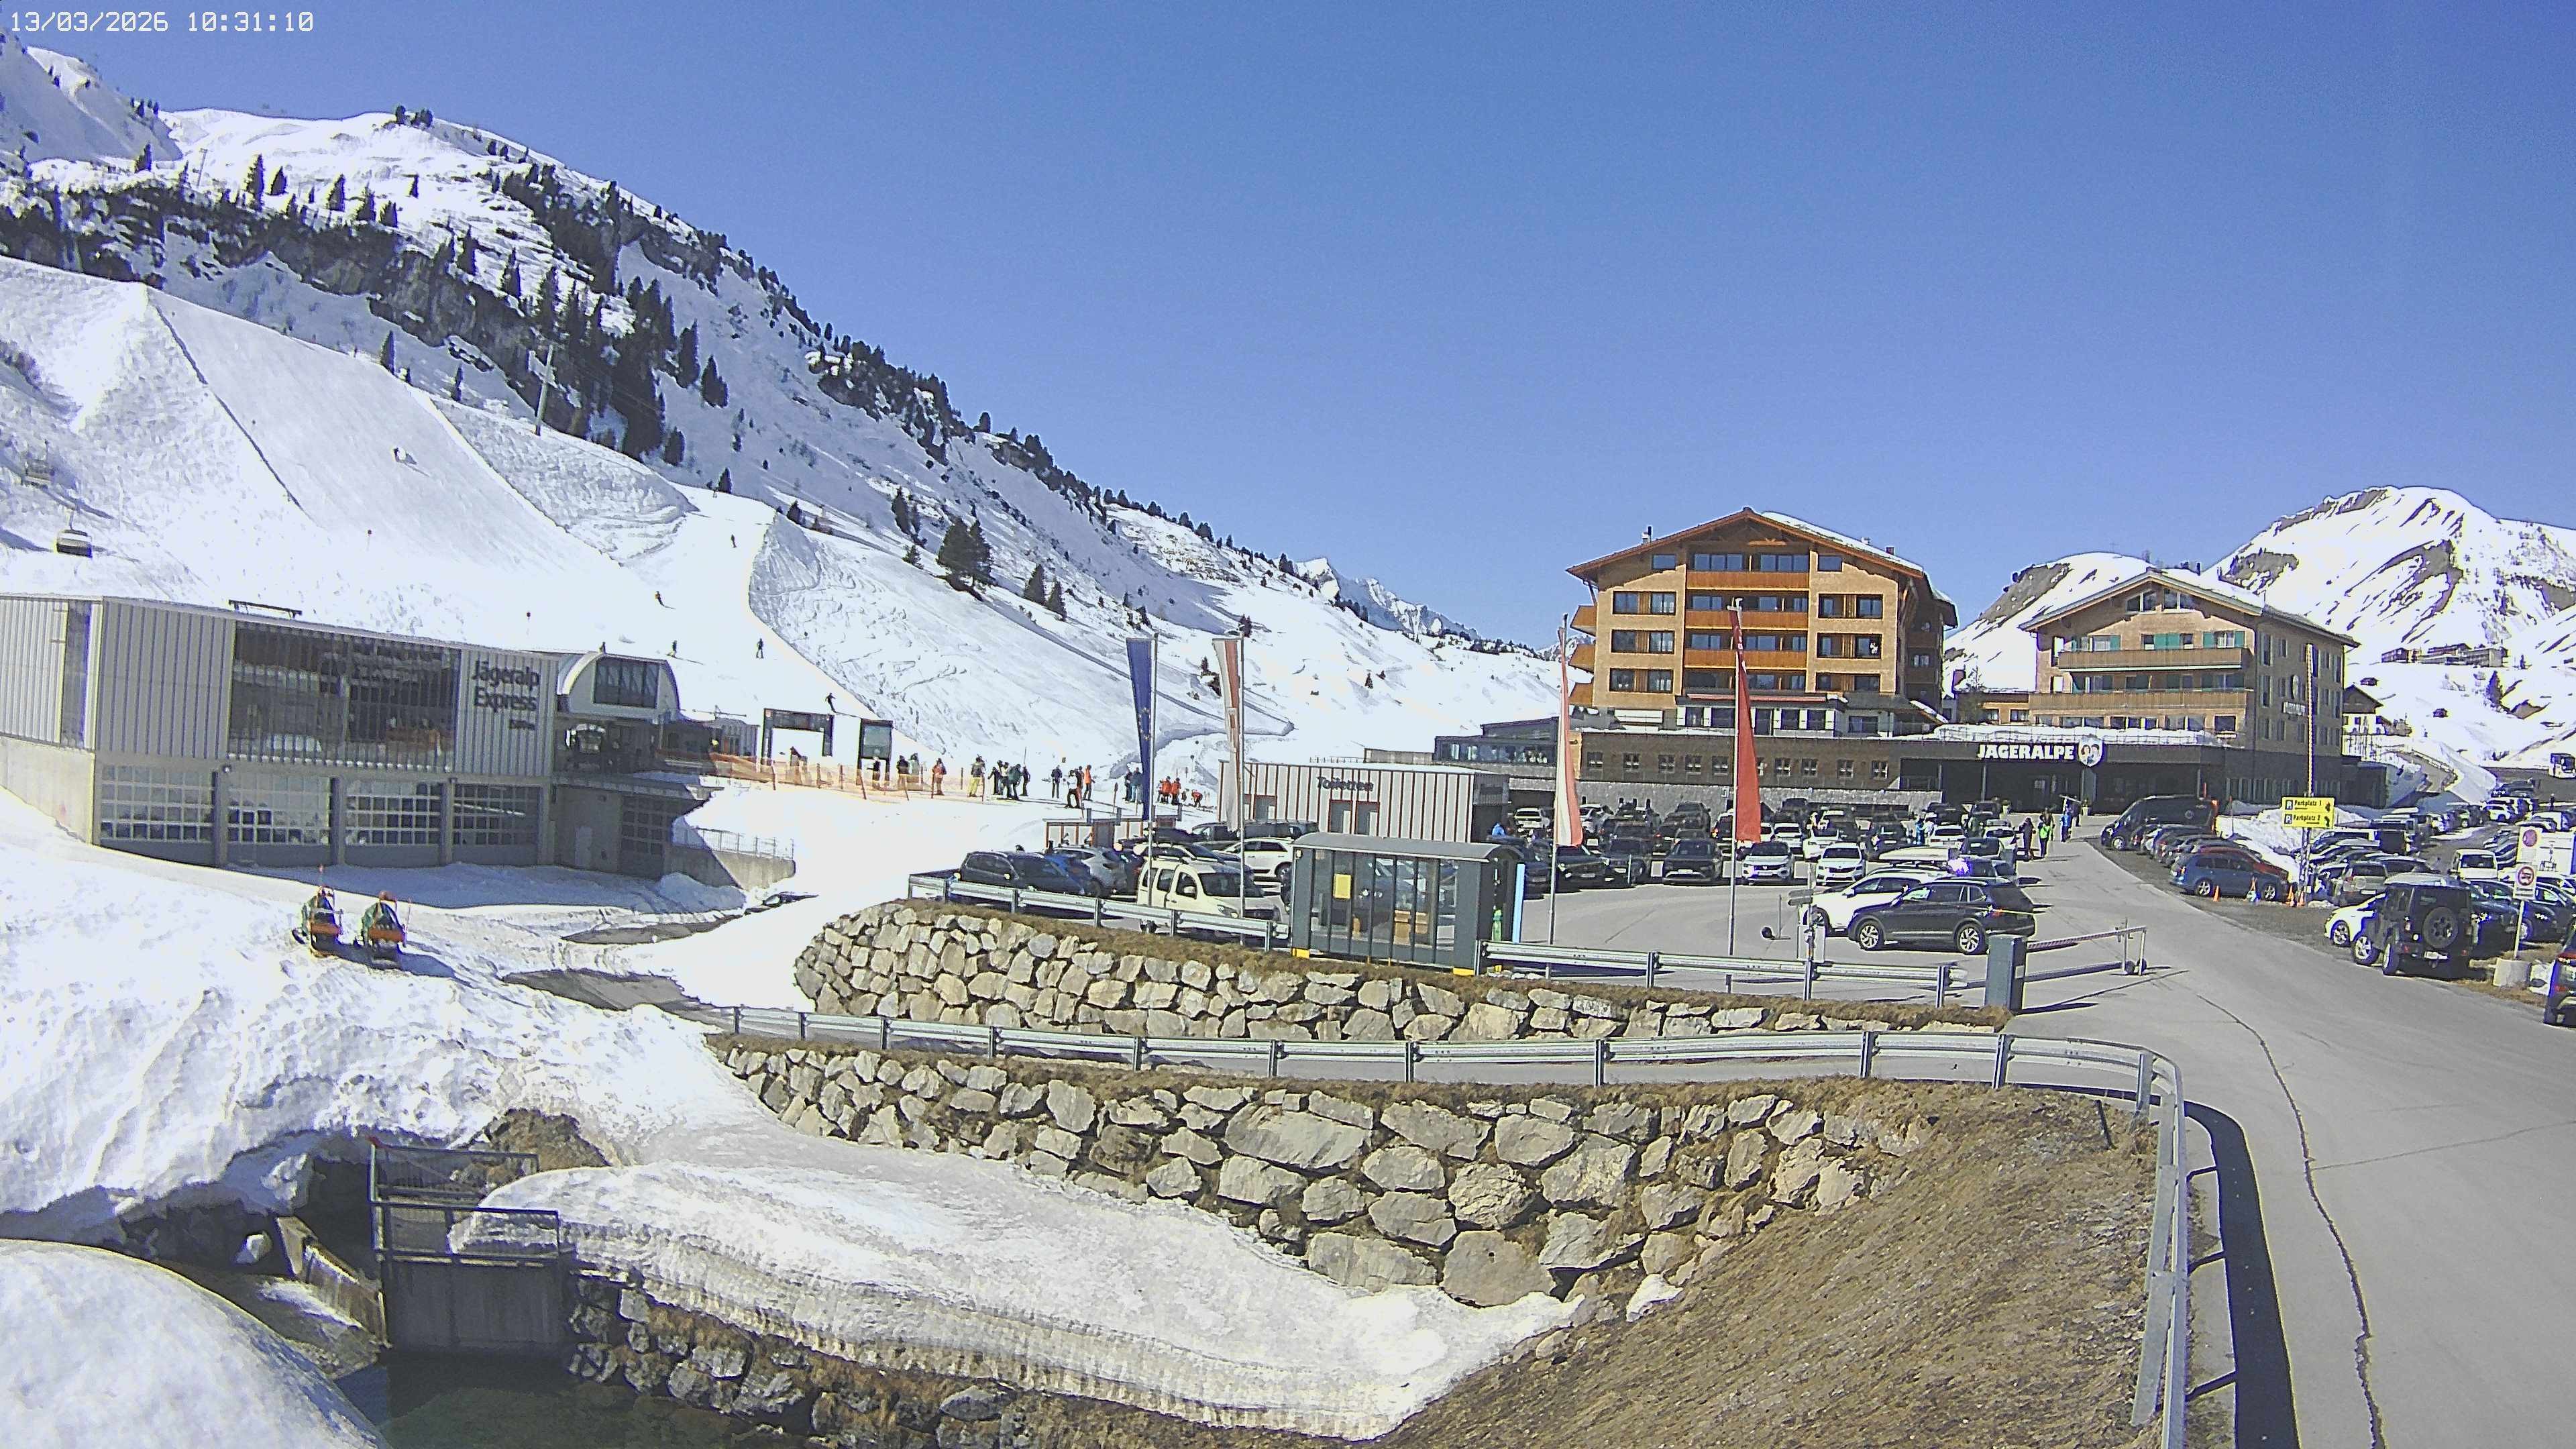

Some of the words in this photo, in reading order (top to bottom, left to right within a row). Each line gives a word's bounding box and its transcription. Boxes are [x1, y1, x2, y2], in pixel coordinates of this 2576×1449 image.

[472, 660, 540, 691] Jägeralp
[473, 685, 537, 713] Express
[1317, 776, 1374, 792] Toiletten
